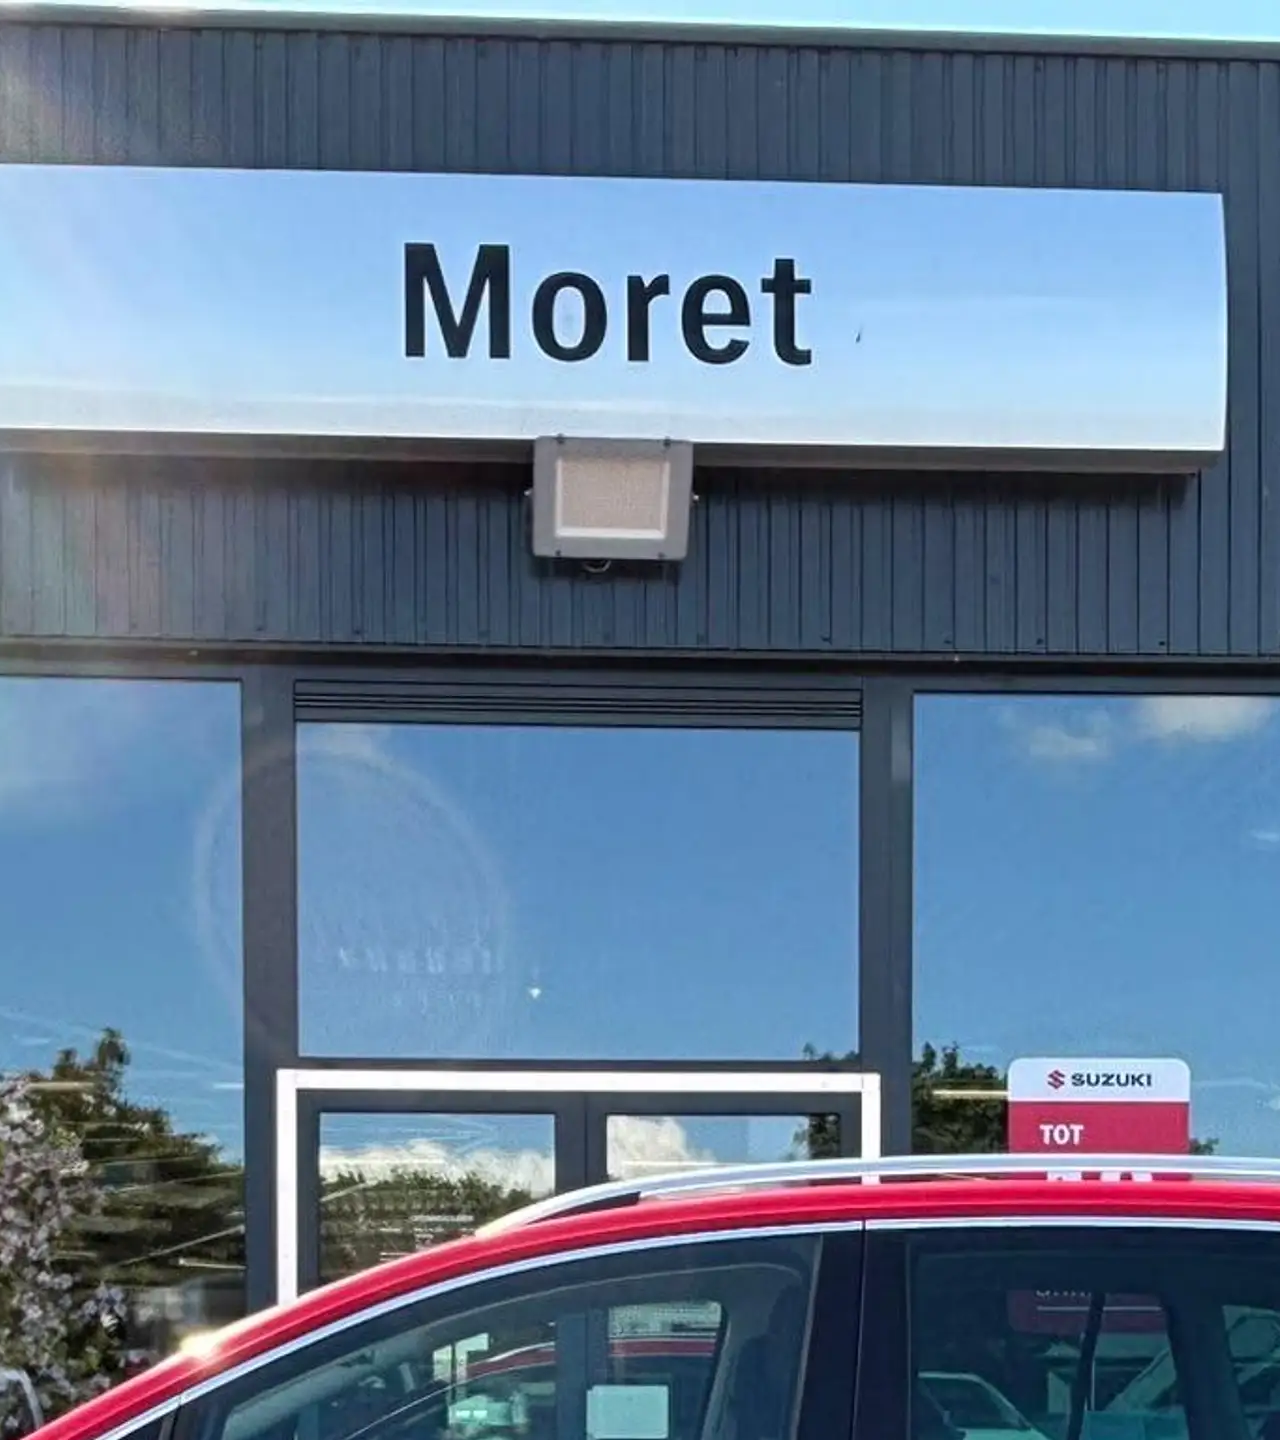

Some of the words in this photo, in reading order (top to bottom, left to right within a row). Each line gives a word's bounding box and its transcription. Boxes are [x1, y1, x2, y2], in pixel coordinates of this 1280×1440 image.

[404, 242, 812, 366] Moret
[1071, 1072, 1152, 1087] SUZUKI
[1039, 1123, 1085, 1146] TOT
